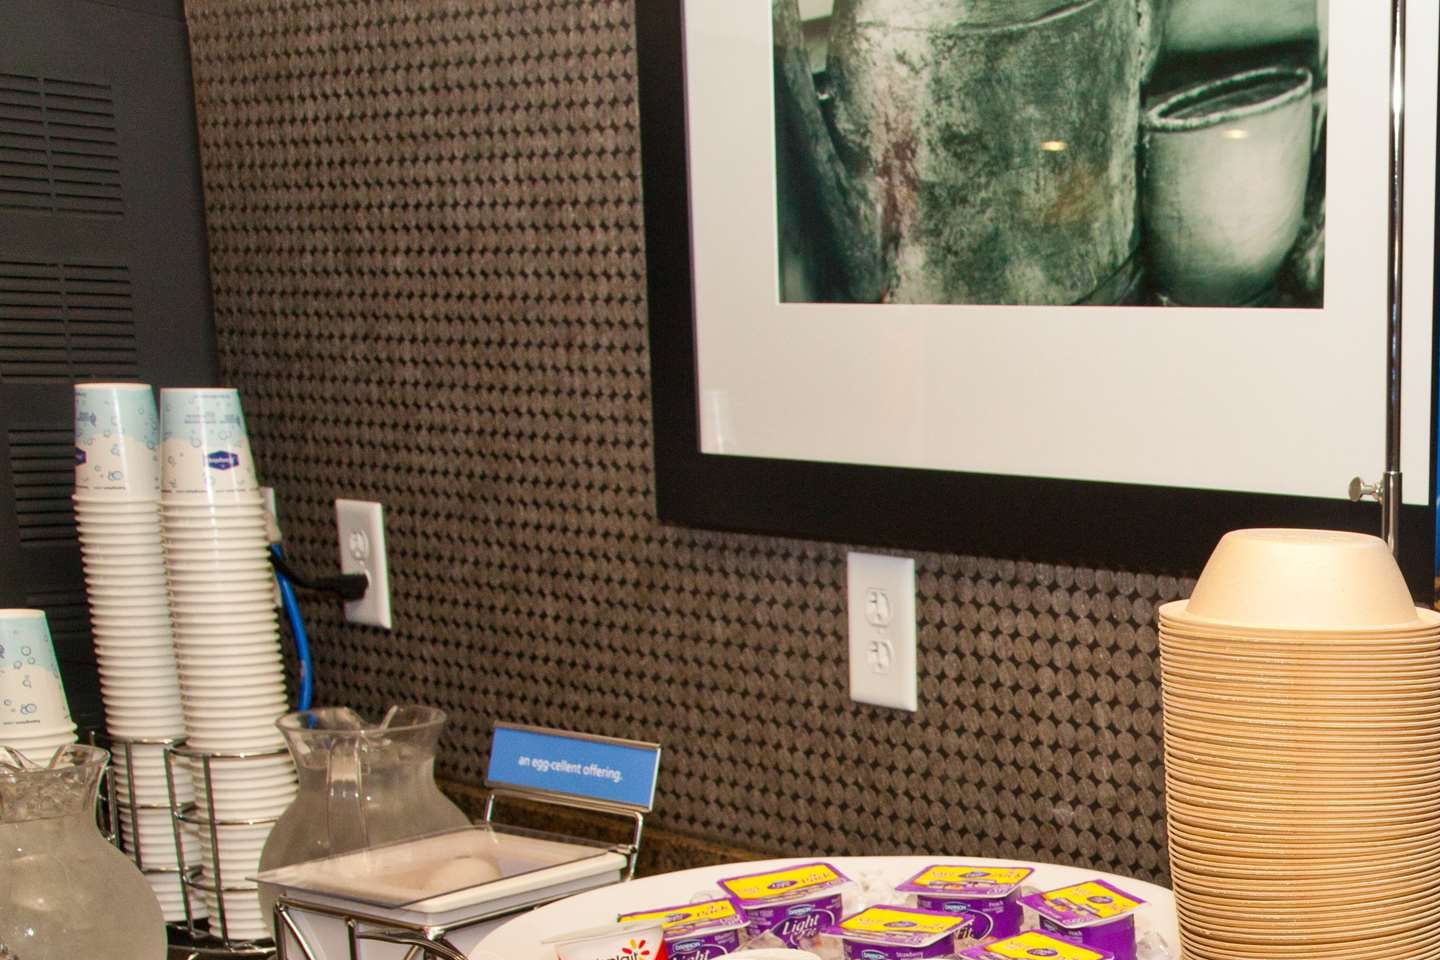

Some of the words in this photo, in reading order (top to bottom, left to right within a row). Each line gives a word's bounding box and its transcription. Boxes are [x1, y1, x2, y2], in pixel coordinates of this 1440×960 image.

[518, 755, 530, 767] an
[532, 758, 582, 775] egg-cellent
[583, 762, 623, 784] offering.
